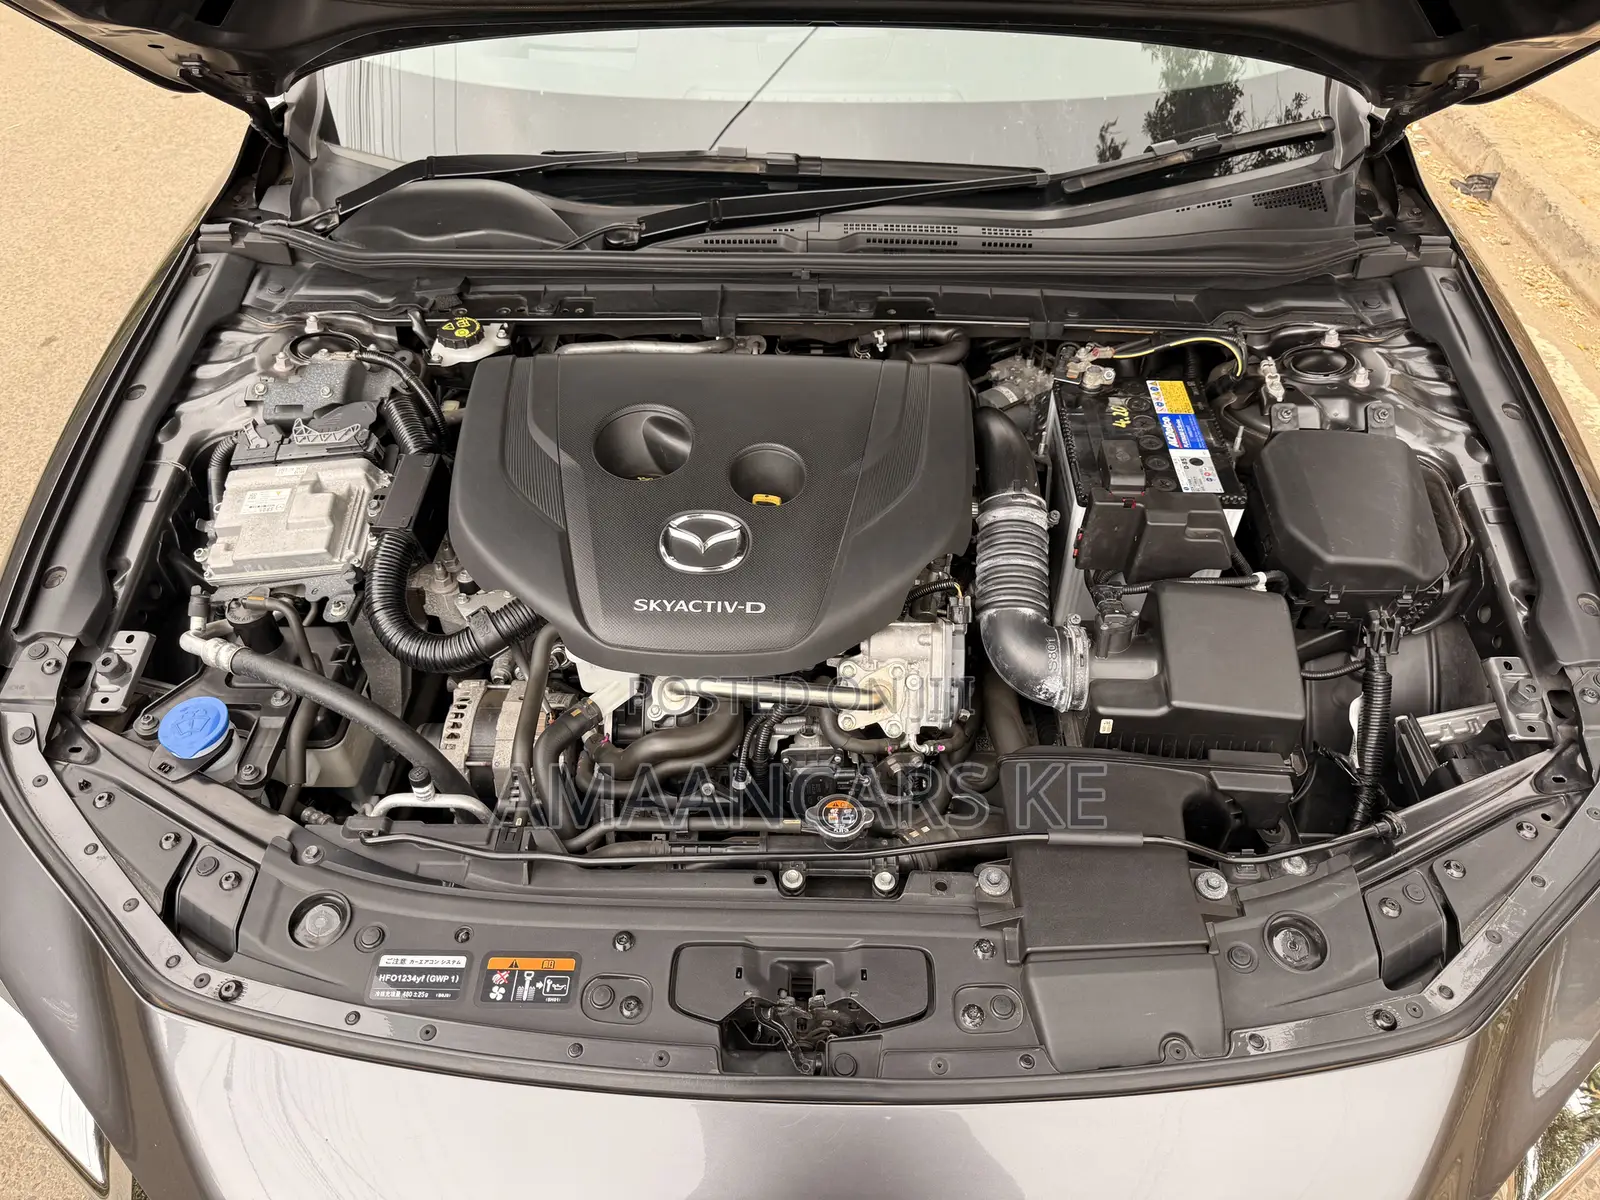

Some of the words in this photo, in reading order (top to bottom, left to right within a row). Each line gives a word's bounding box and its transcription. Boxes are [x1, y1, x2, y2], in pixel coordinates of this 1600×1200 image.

[1161, 416, 1180, 448] ACDelco
[633, 598, 766, 614] SKYACTIV-D
[1045, 636, 1059, 672] S801
[385, 958, 407, 966] ご注意
[378, 974, 425, 984] HFO1234yf
[426, 974, 449, 984] (GWP
